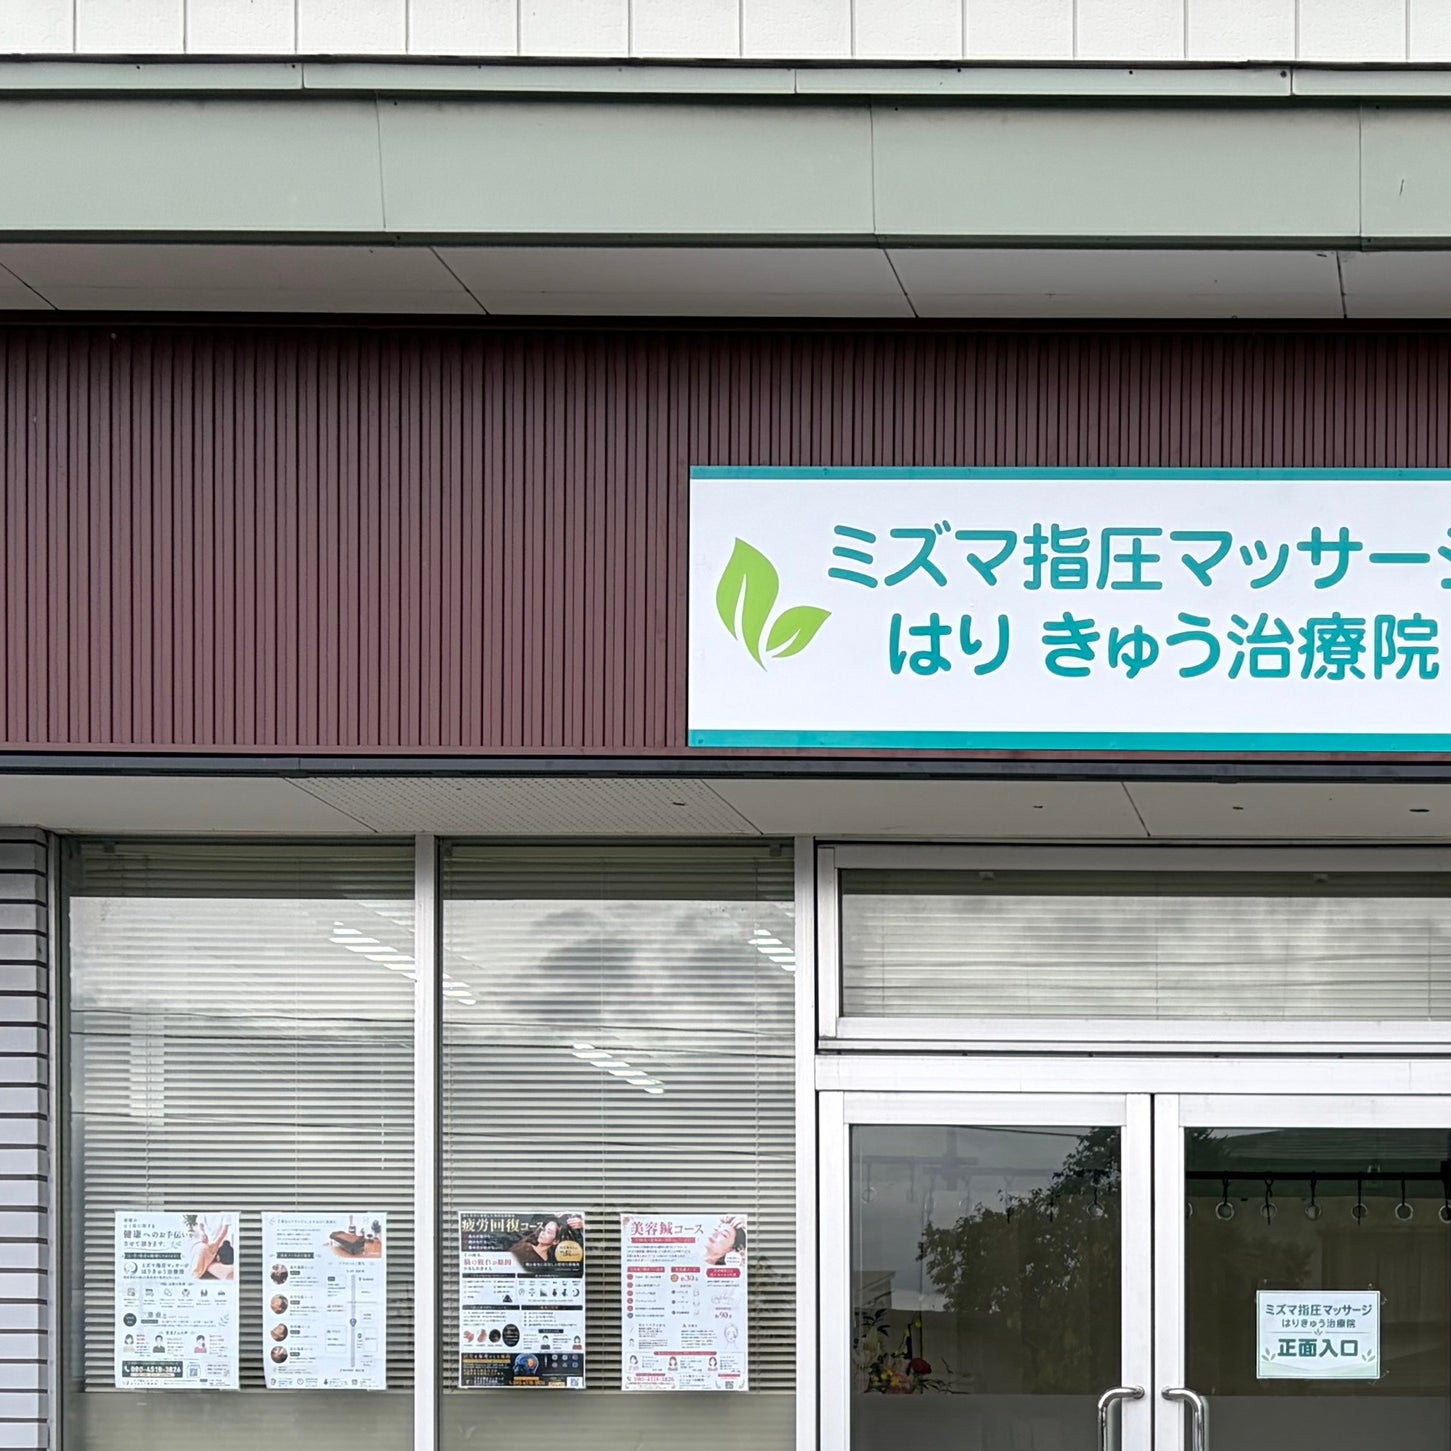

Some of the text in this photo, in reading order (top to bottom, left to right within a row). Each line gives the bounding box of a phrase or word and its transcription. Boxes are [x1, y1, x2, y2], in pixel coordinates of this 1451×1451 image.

[889, 612, 1441, 682] はり きゅう治療院
[462, 1218, 545, 1233] 疲労回復コース
[631, 1221, 704, 1236] 美容鍼コース
[1265, 1303, 1373, 1316] ミズマ指圧マッサージ
[1281, 1318, 1356, 1329] はりきゅう治療院
[1277, 1338, 1359, 1358] 正面入口
